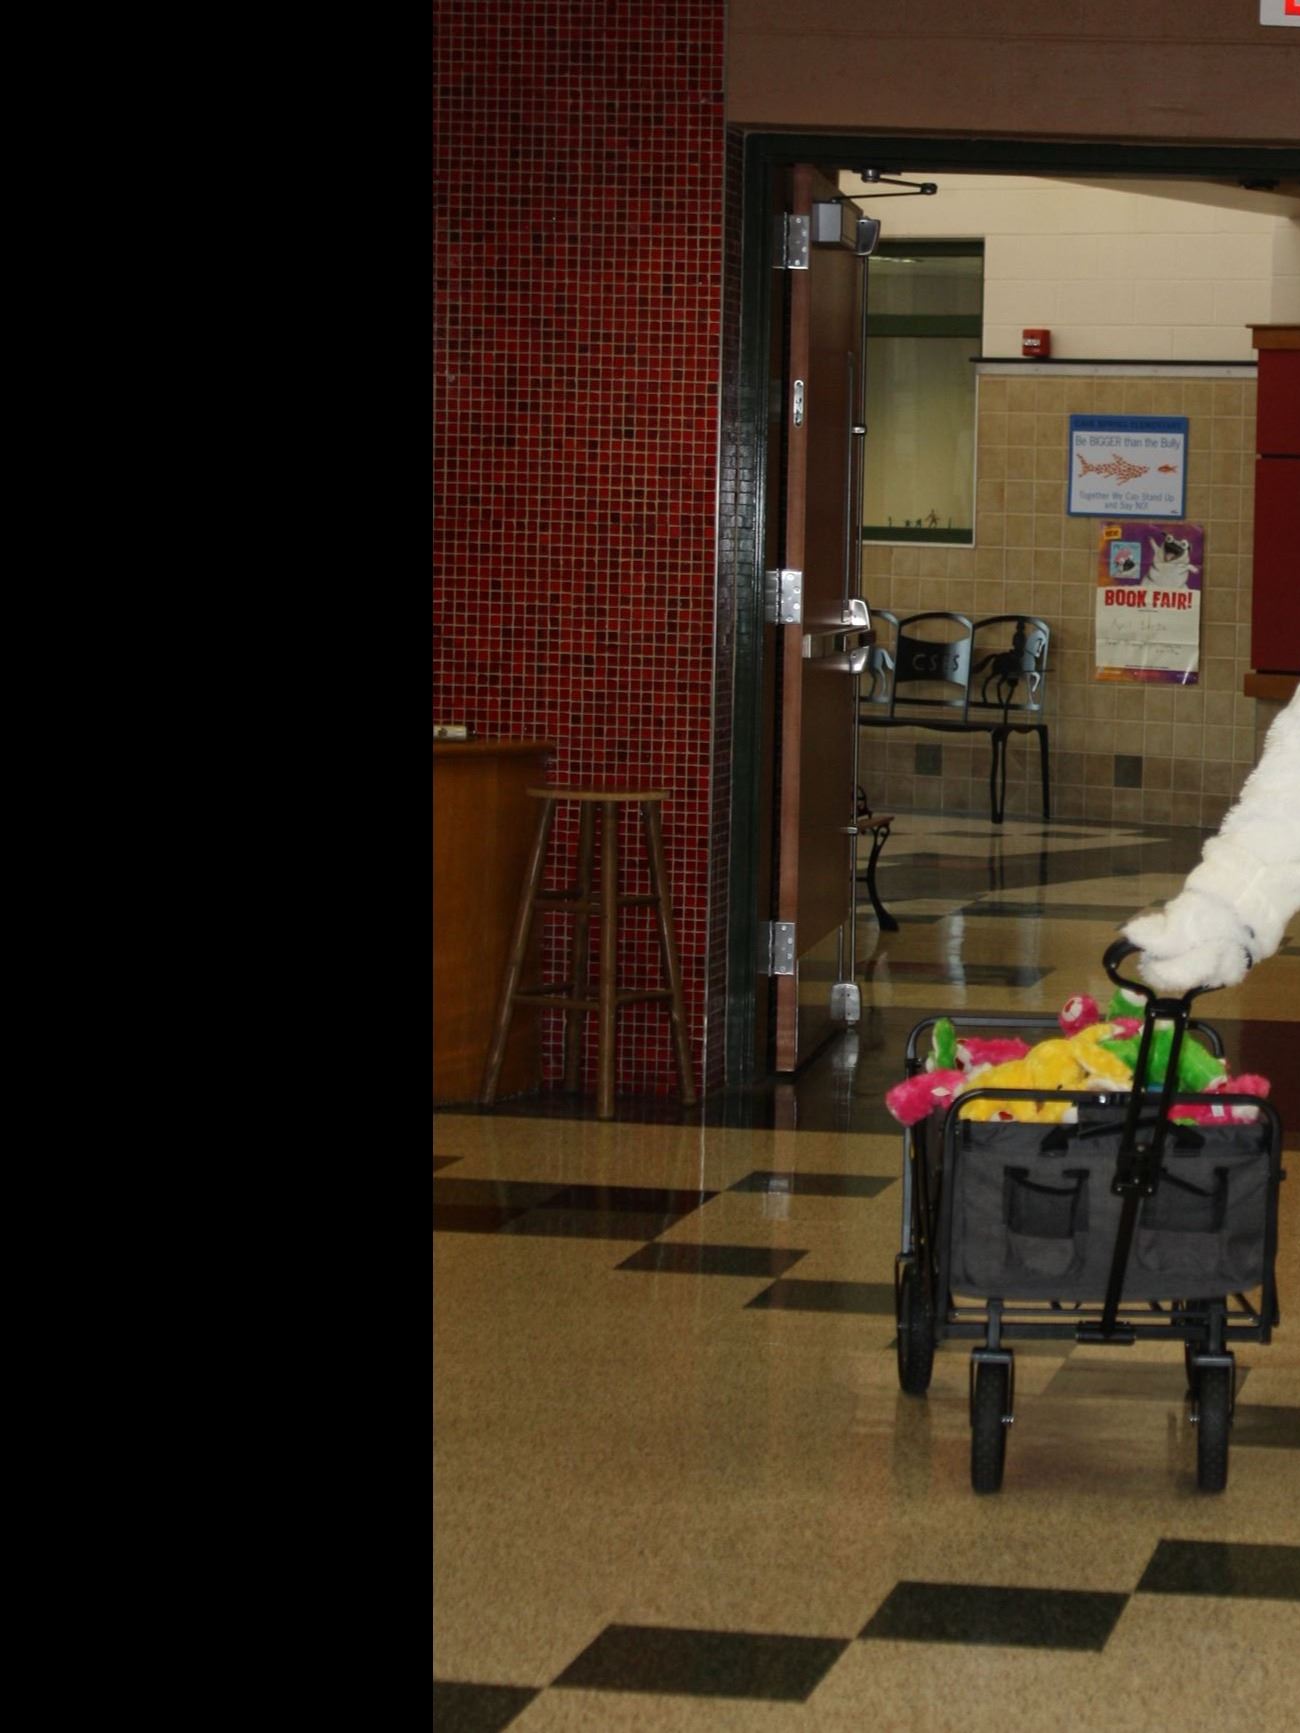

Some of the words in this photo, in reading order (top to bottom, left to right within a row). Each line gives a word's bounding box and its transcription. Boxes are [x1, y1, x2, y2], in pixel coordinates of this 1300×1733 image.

[1075, 435, 1087, 447] Be
[1090, 435, 1121, 447] BIGGER
[1124, 437, 1143, 448] than
[1145, 438, 1159, 448] the
[1160, 438, 1180, 450] Bully
[1105, 589, 1147, 609] BOOK
[1152, 591, 1193, 610] FAIR!
